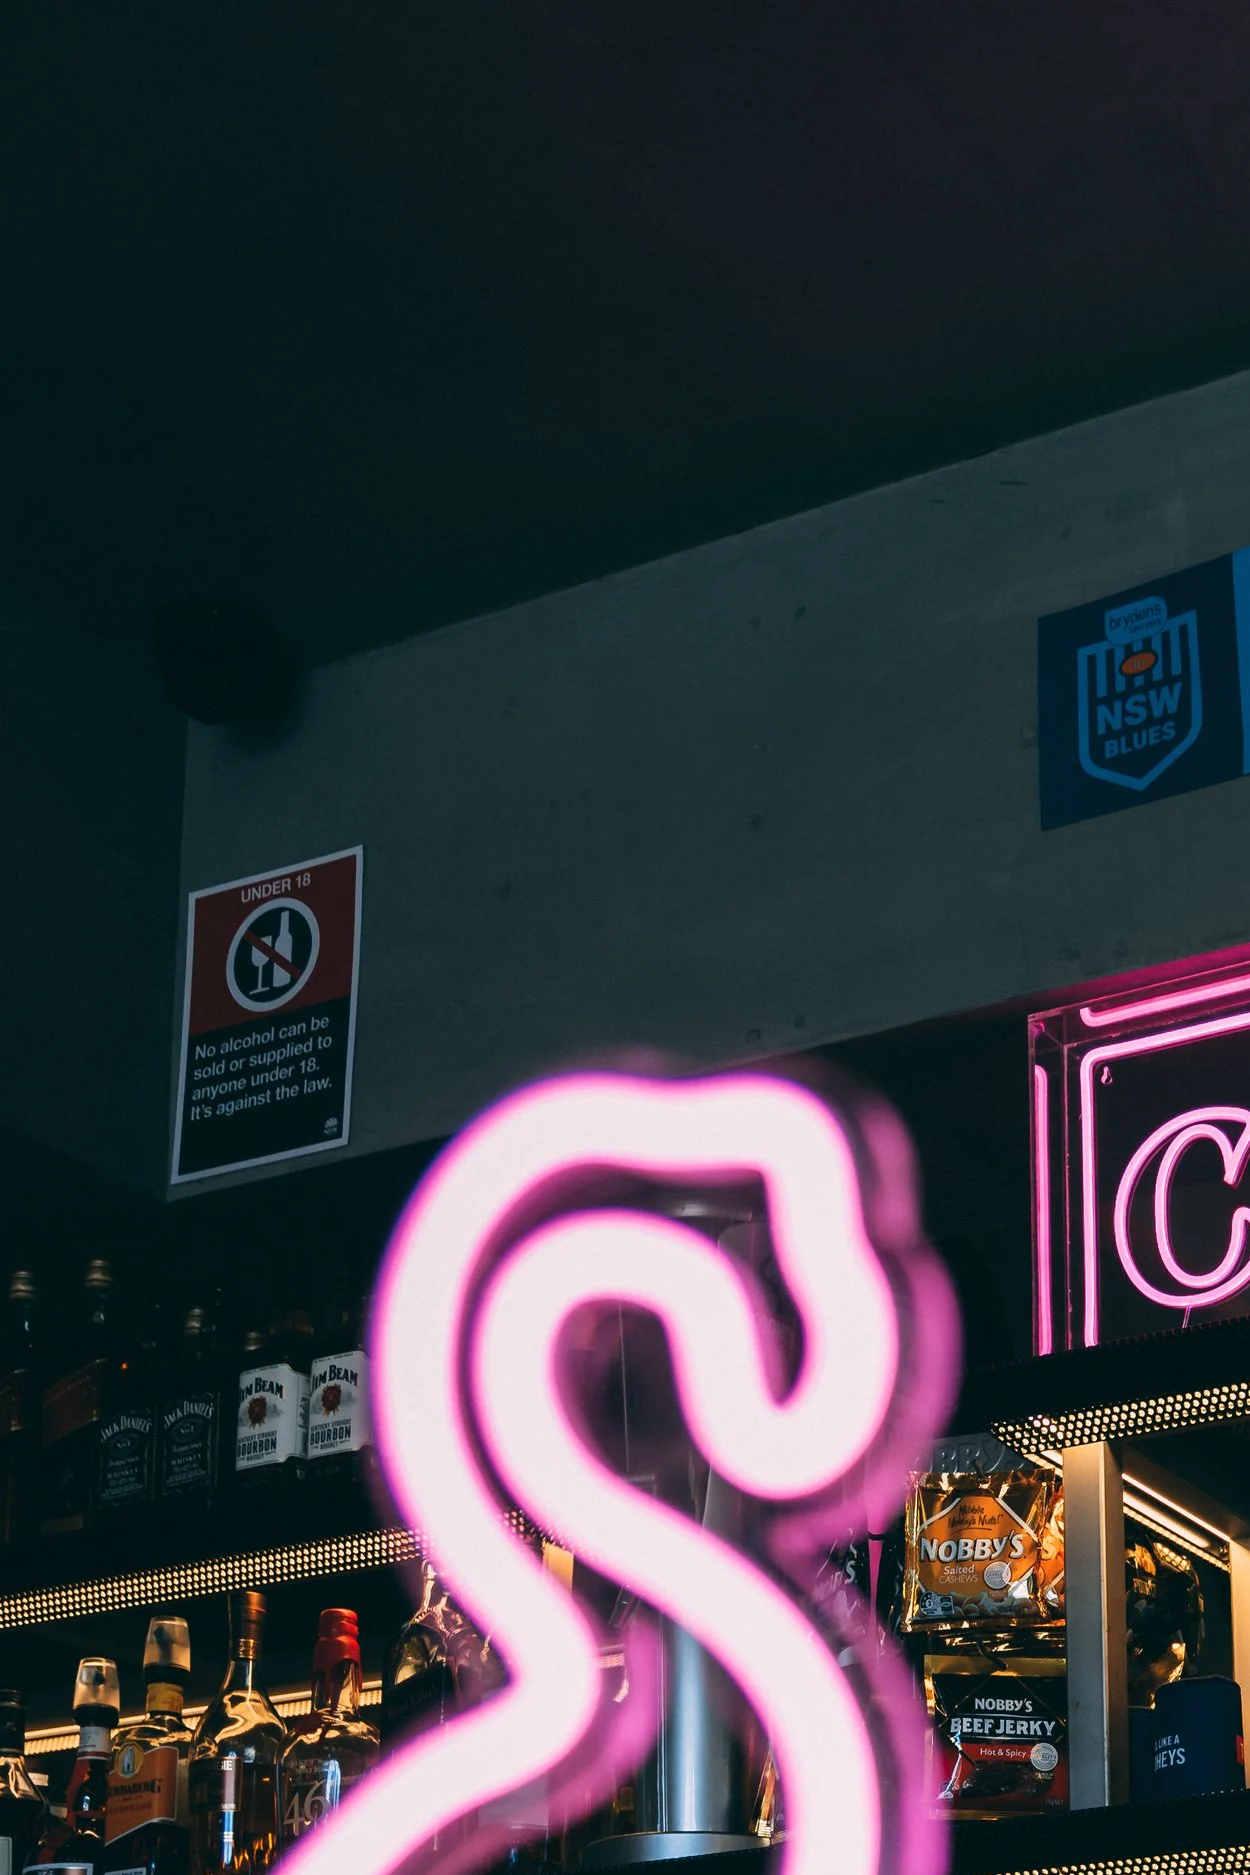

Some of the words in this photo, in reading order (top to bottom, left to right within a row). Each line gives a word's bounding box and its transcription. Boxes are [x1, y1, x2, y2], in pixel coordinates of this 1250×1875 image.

[1109, 602, 1162, 631] brydens
[1097, 681, 1182, 736] NSW
[1105, 721, 1176, 758] BLUES
[241, 877, 291, 903] UNDER
[296, 872, 311, 889] 18
[195, 1044, 216, 1061] No
[220, 1026, 275, 1055] alcohol
[278, 1021, 306, 1040] can
[310, 1016, 329, 1032] be
[194, 1058, 226, 1081] sold
[229, 1057, 246, 1072] or
[249, 1040, 312, 1069] supplied
[318, 1035, 332, 1050] to
[192, 1076, 246, 1101] anyone
[250, 1063, 295, 1087] under
[300, 1057, 320, 1074] 18.
[191, 1104, 212, 1121] It's
[216, 1090, 272, 1117] against
[276, 1081, 299, 1101] the
[303, 1075, 333, 1093] law.
[255, 1377, 283, 1400] BEAM
[329, 1364, 358, 1387] BEAM
[310, 1425, 351, 1446] BOURBON
[920, 1529, 1025, 1563] NOBBY'S
[938, 1575, 978, 1585] CASHEWS
[944, 1563, 975, 1577] Salted
[974, 1698, 1033, 1713] NOBBY'S
[950, 1717, 995, 1734] BEEF
[995, 1719, 1056, 1736] JERKY
[980, 1748, 996, 1756] Hot
[1005, 1748, 1027, 1758] Spicy
